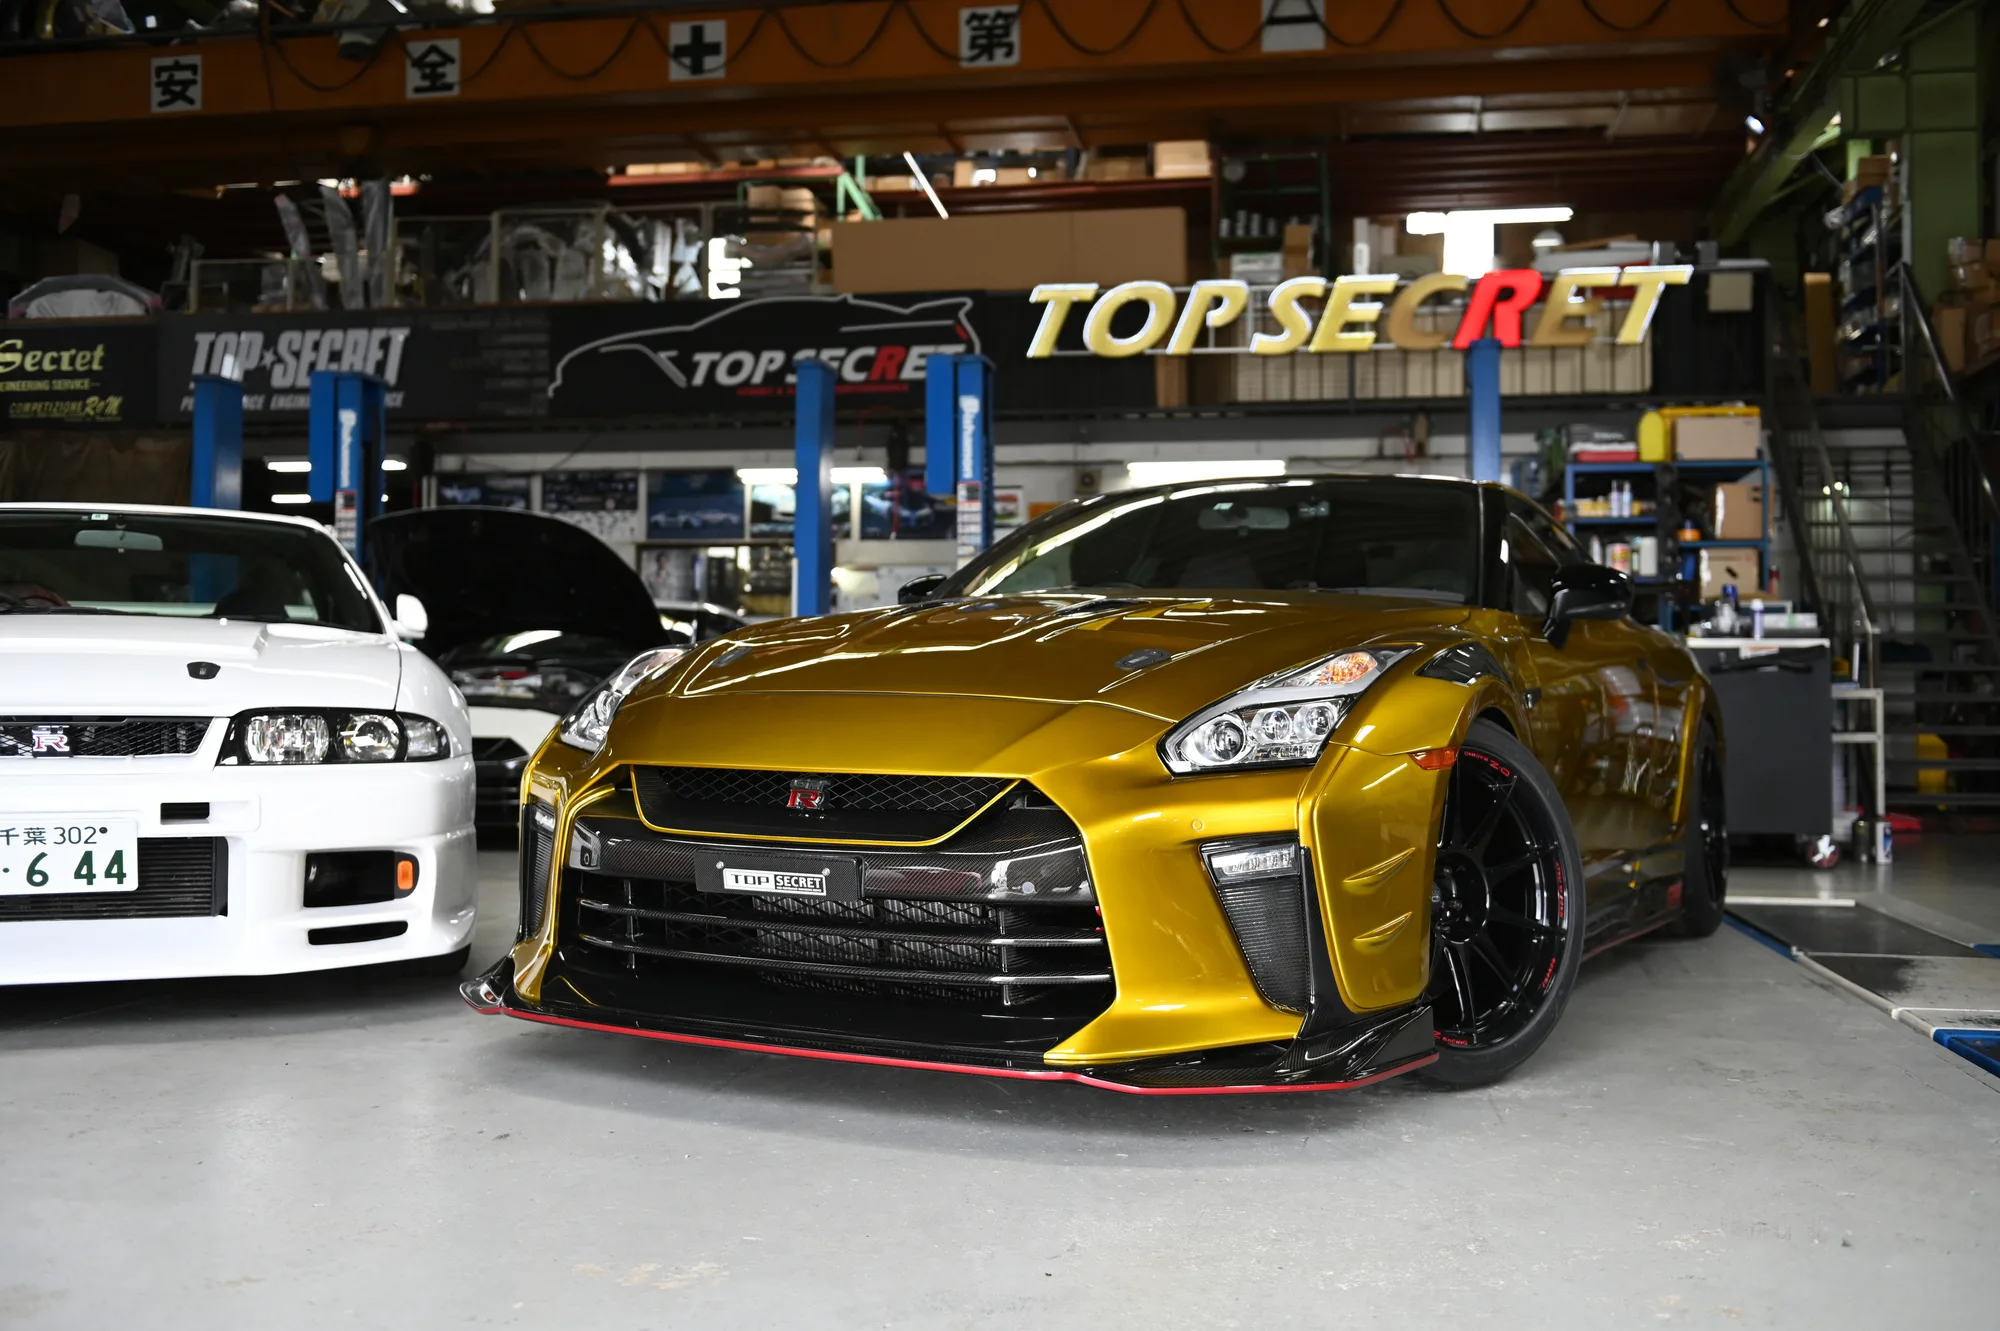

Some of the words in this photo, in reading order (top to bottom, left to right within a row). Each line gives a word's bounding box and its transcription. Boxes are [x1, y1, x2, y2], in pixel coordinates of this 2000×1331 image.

[154, 58, 199, 107] 安
[411, 44, 456, 94] 全
[965, 10, 1017, 63] 第
[1027, 280, 1249, 359] TOP
[1249, 263, 1694, 356] SECRET
[0, 339, 105, 373] Secret
[191, 331, 265, 382] TOP
[270, 327, 411, 388] SECRET
[691, 349, 786, 387] TOP
[785, 344, 966, 383] SECRE
[0, 827, 47, 845] 千葉
[53, 826, 98, 845] 302
[73, 849, 127, 886] 44
[730, 873, 770, 886] TOP
[776, 875, 822, 889] SECRET
